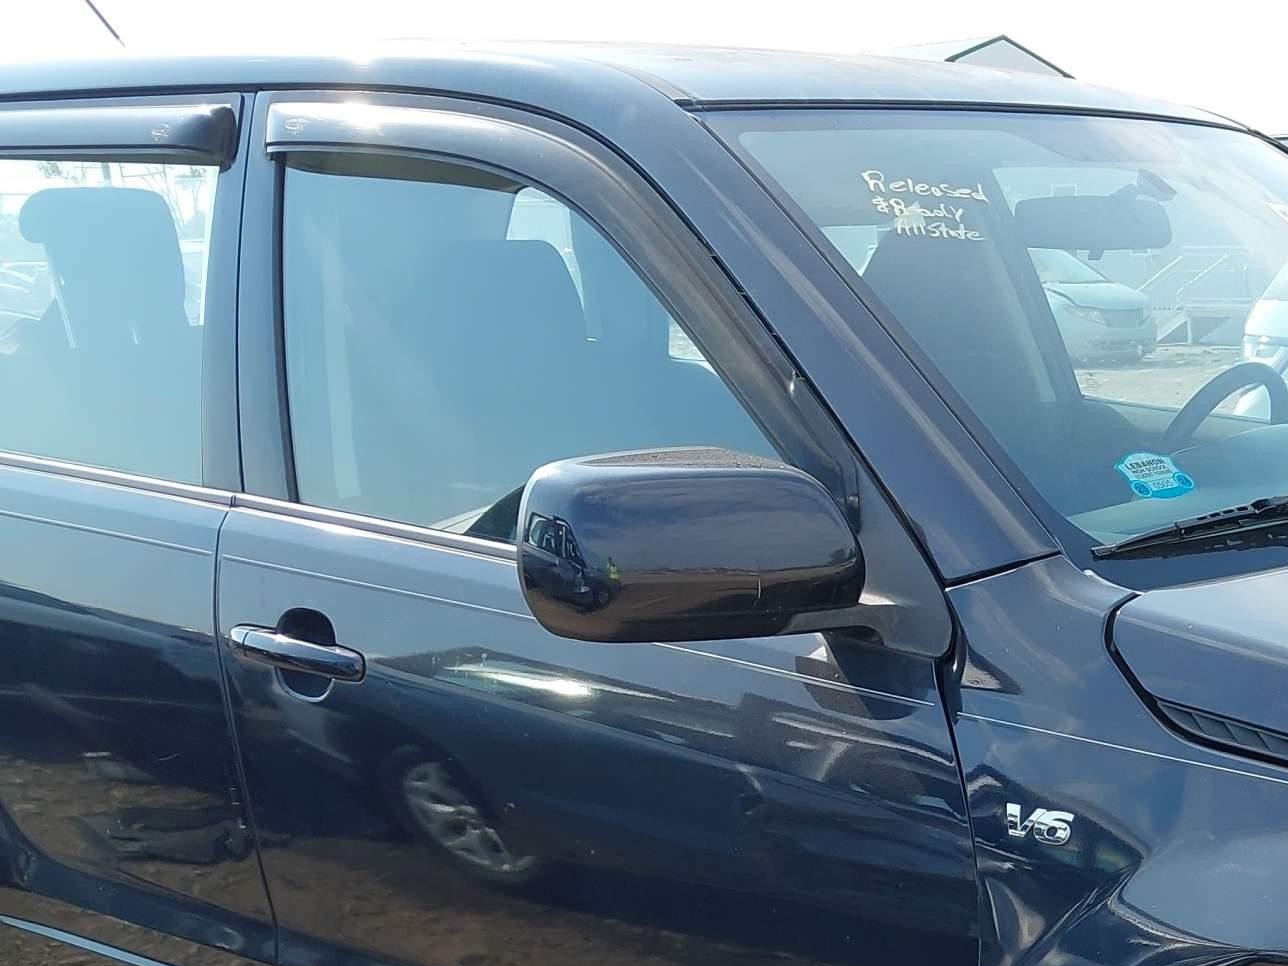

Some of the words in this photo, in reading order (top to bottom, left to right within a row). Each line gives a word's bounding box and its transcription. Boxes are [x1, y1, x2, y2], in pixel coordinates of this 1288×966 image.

[861, 170, 989, 202] Released
[1124, 458, 1165, 470] LEBANON
[1006, 802, 1075, 846] V6
